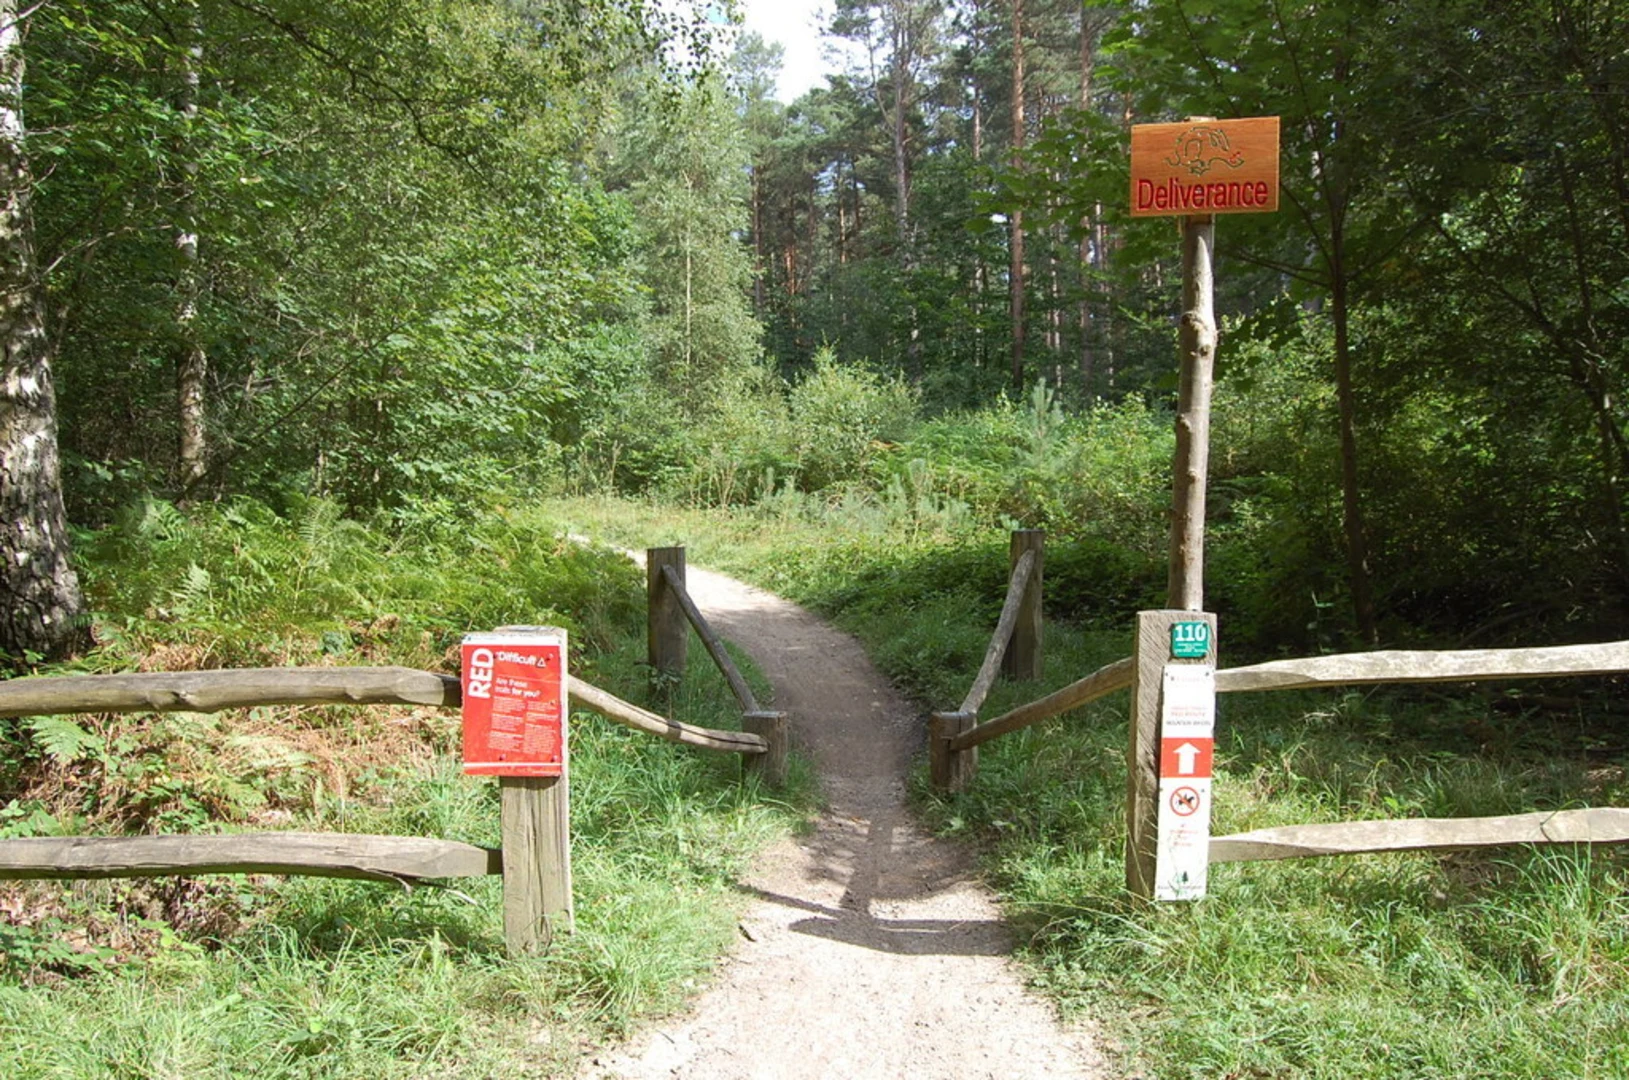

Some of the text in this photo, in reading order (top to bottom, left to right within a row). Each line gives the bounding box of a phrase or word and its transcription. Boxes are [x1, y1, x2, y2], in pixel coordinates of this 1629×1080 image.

[1137, 177, 1268, 210] Deliverance
[1175, 624, 1206, 642] 110
[498, 651, 537, 666] Difficult
[467, 648, 494, 699] RED
[511, 687, 523, 696] for
